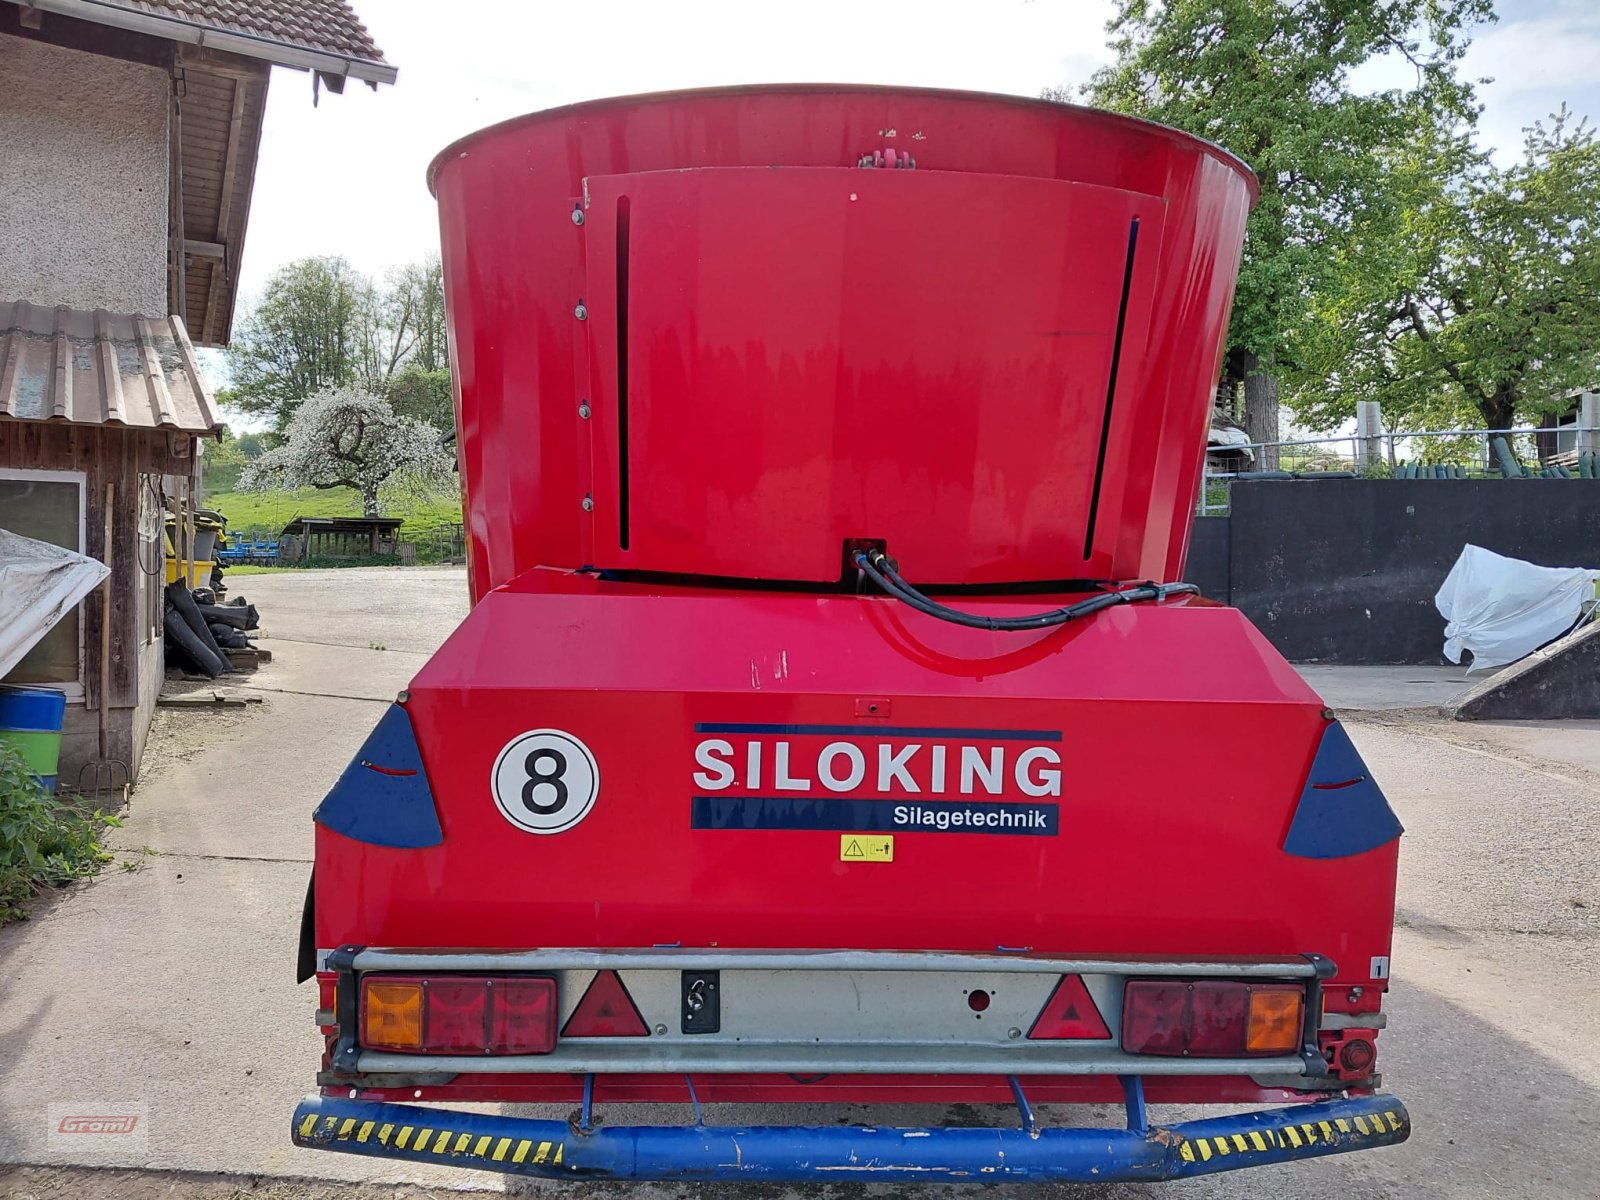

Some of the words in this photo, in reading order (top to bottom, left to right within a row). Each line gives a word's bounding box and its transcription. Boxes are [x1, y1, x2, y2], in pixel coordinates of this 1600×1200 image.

[522, 748, 568, 815] 8
[692, 739, 1062, 796] SILOKING
[893, 806, 1047, 830] Silagetechnik
